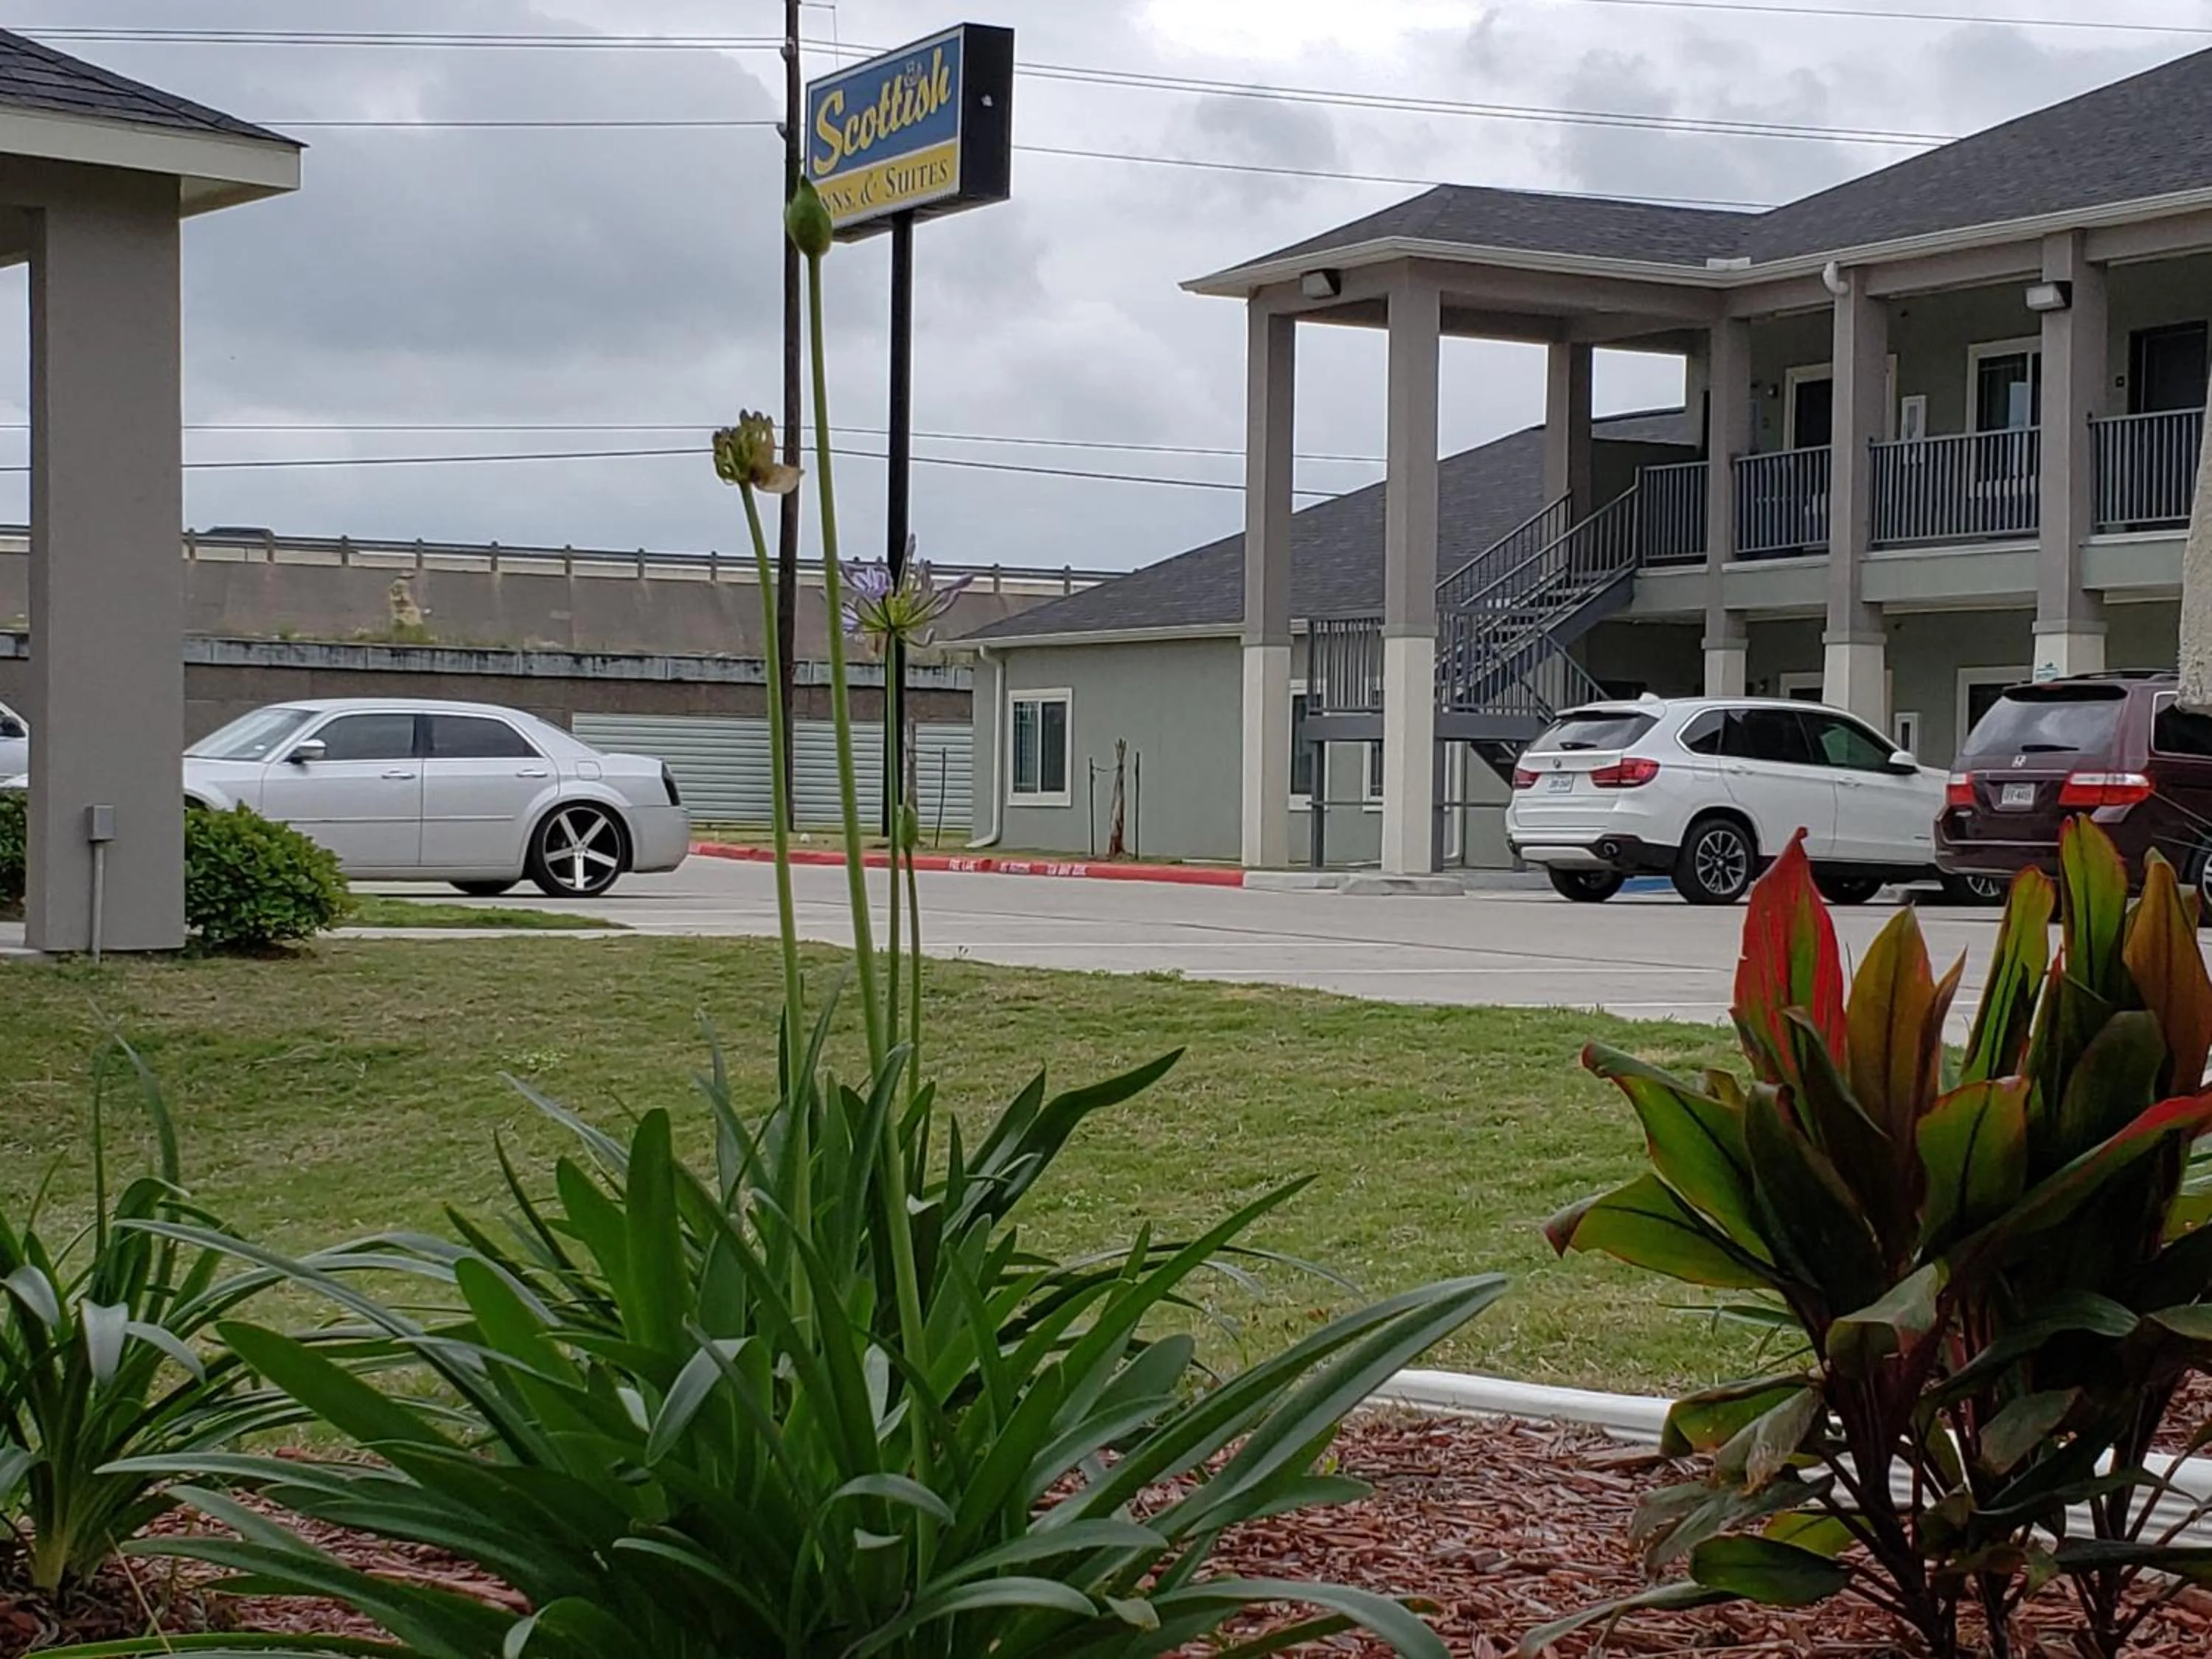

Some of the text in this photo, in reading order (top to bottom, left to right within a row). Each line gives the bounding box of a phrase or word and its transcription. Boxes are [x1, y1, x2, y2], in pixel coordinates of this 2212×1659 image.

[813, 47, 951, 175] Scottish
[820, 159, 948, 214] NNS & SUITES
